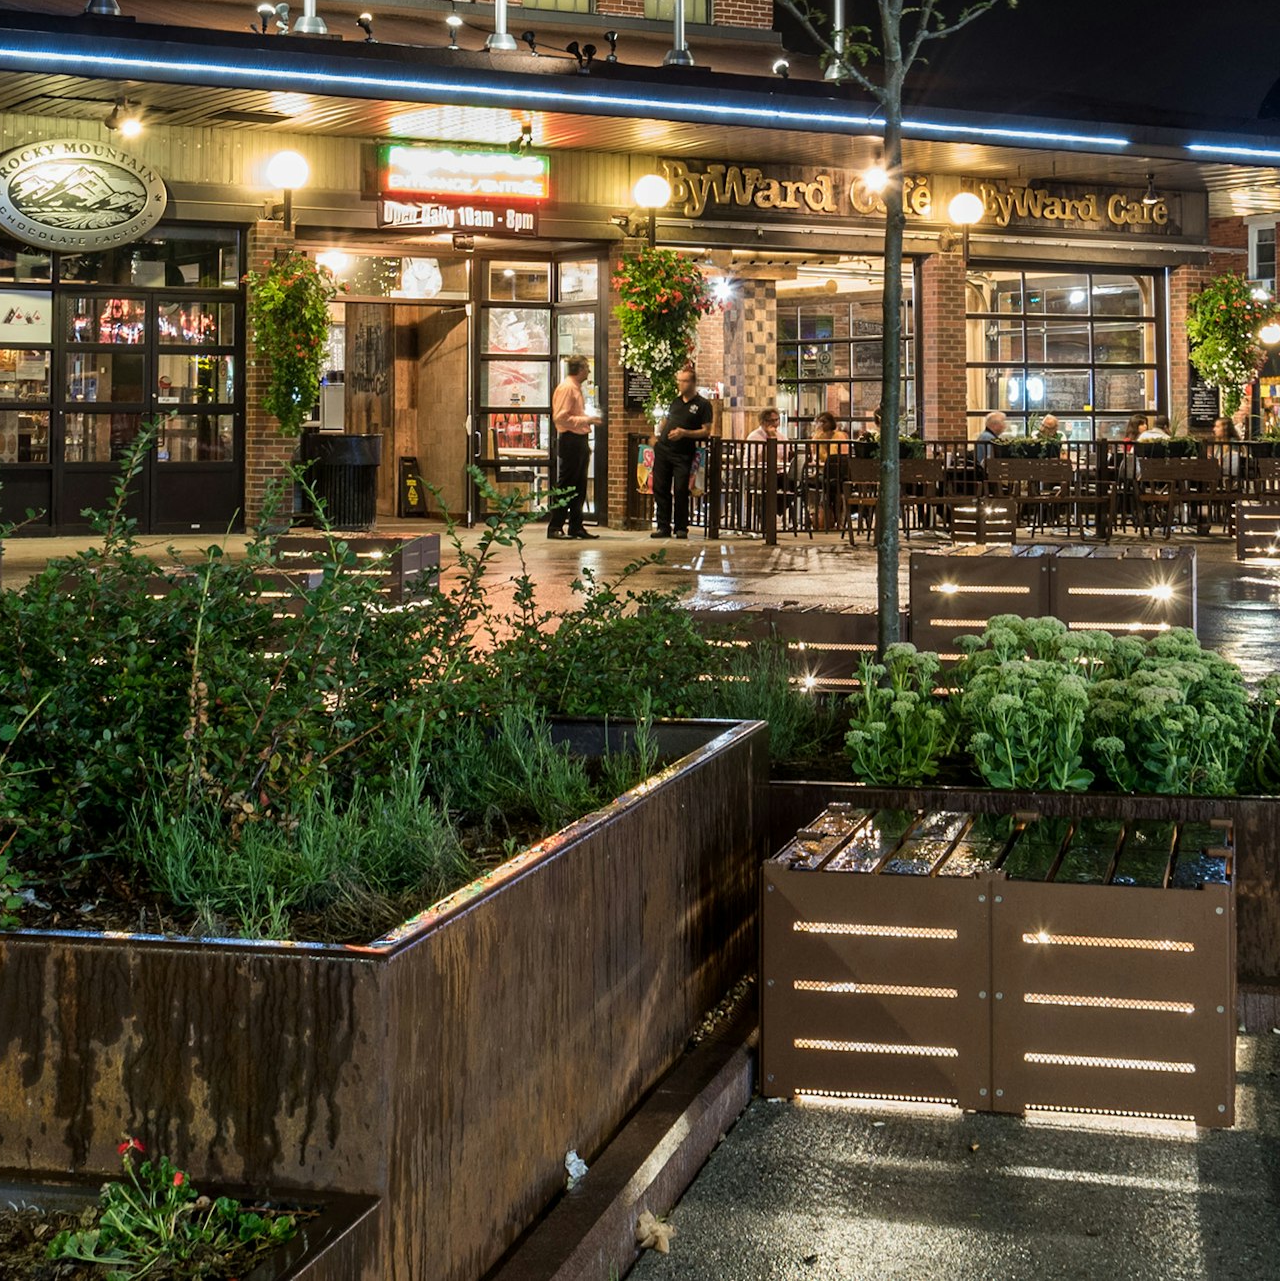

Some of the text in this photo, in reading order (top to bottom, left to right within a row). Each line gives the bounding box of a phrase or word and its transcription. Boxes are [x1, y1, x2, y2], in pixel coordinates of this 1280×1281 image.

[63, 142, 157, 185] MOUNTAIN
[662, 159, 838, 218] ByWard
[980, 182, 1169, 227] ByWard Café
[94, 212, 153, 246] FACTORY
[457, 206, 494, 228] 10am
[505, 209, 534, 233] 8pm
